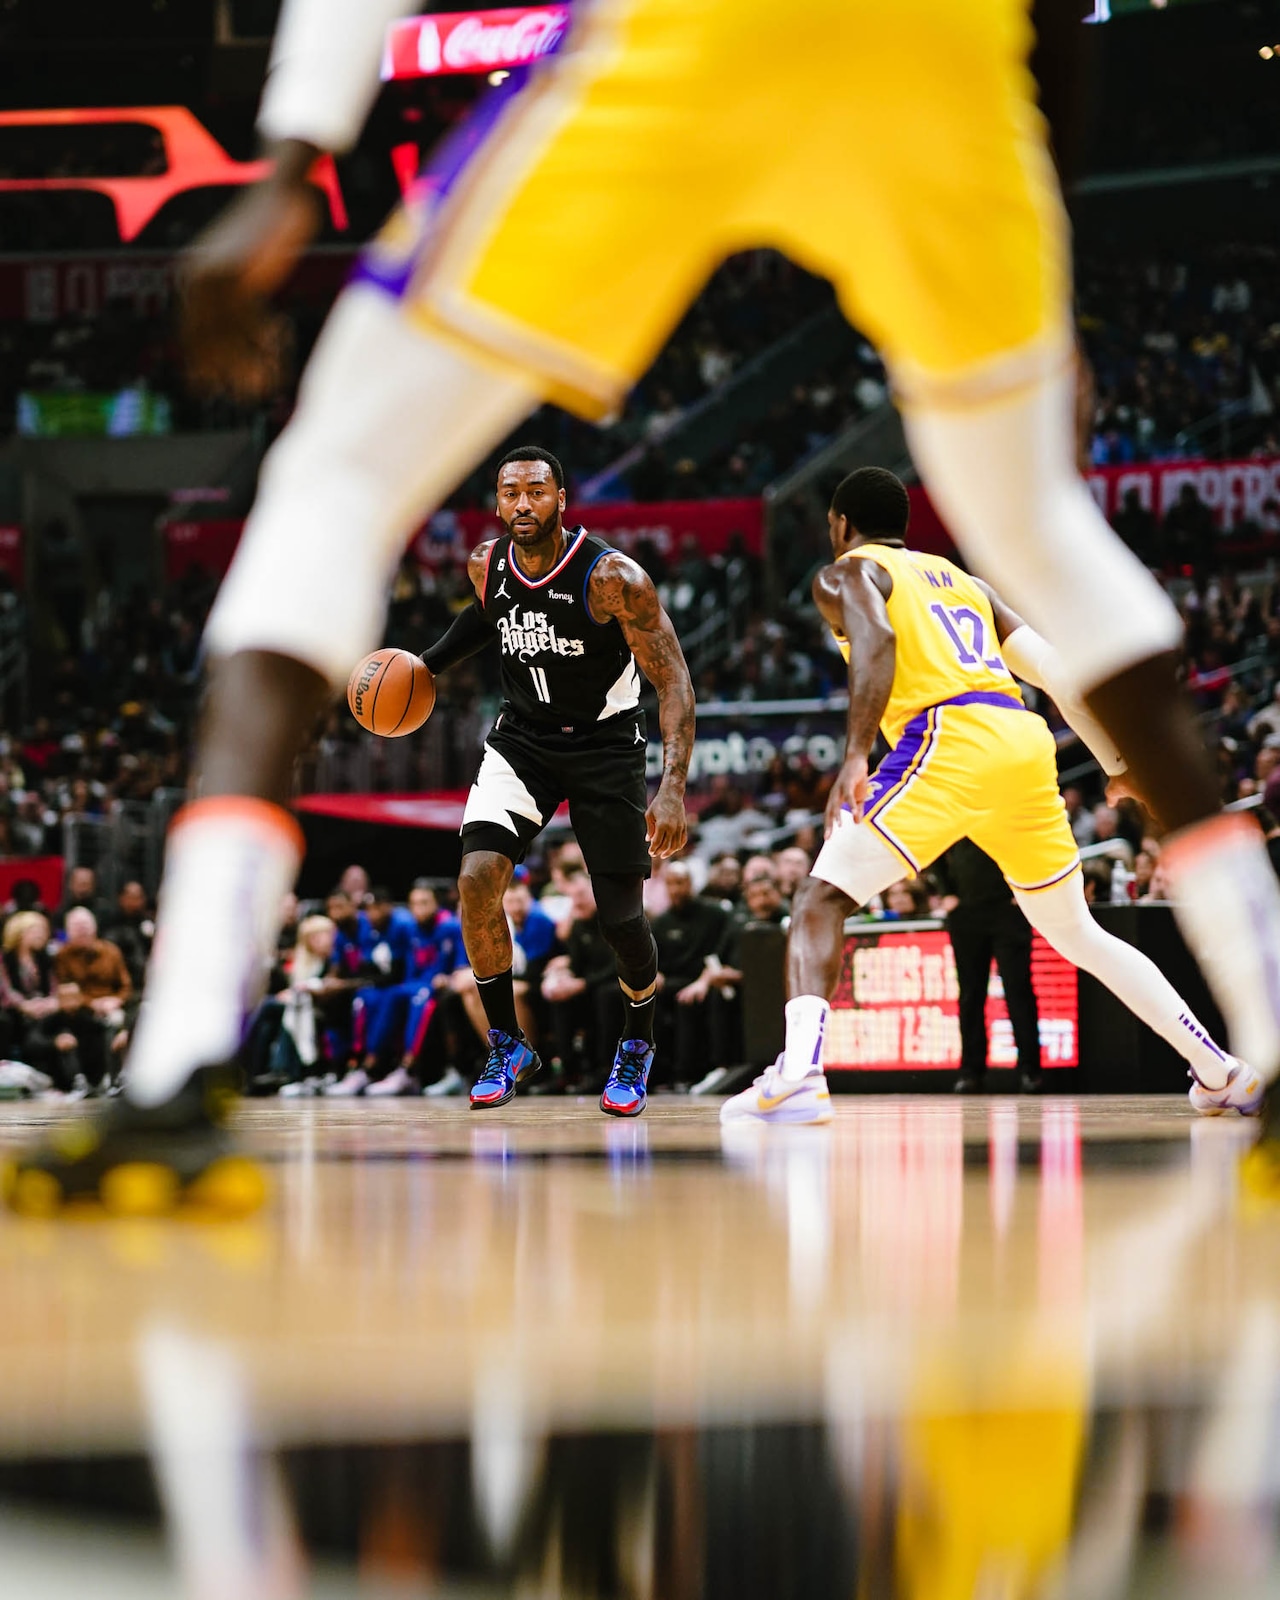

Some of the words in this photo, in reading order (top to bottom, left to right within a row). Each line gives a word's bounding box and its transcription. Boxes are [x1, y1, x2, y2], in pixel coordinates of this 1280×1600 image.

[497, 558, 506, 571] 6
[548, 588, 574, 604] honey
[508, 603, 548, 633] Los
[496, 616, 585, 663] Angeles
[929, 603, 1006, 672] 12
[355, 660, 383, 716] Wilson
[528, 666, 551, 704] 11
